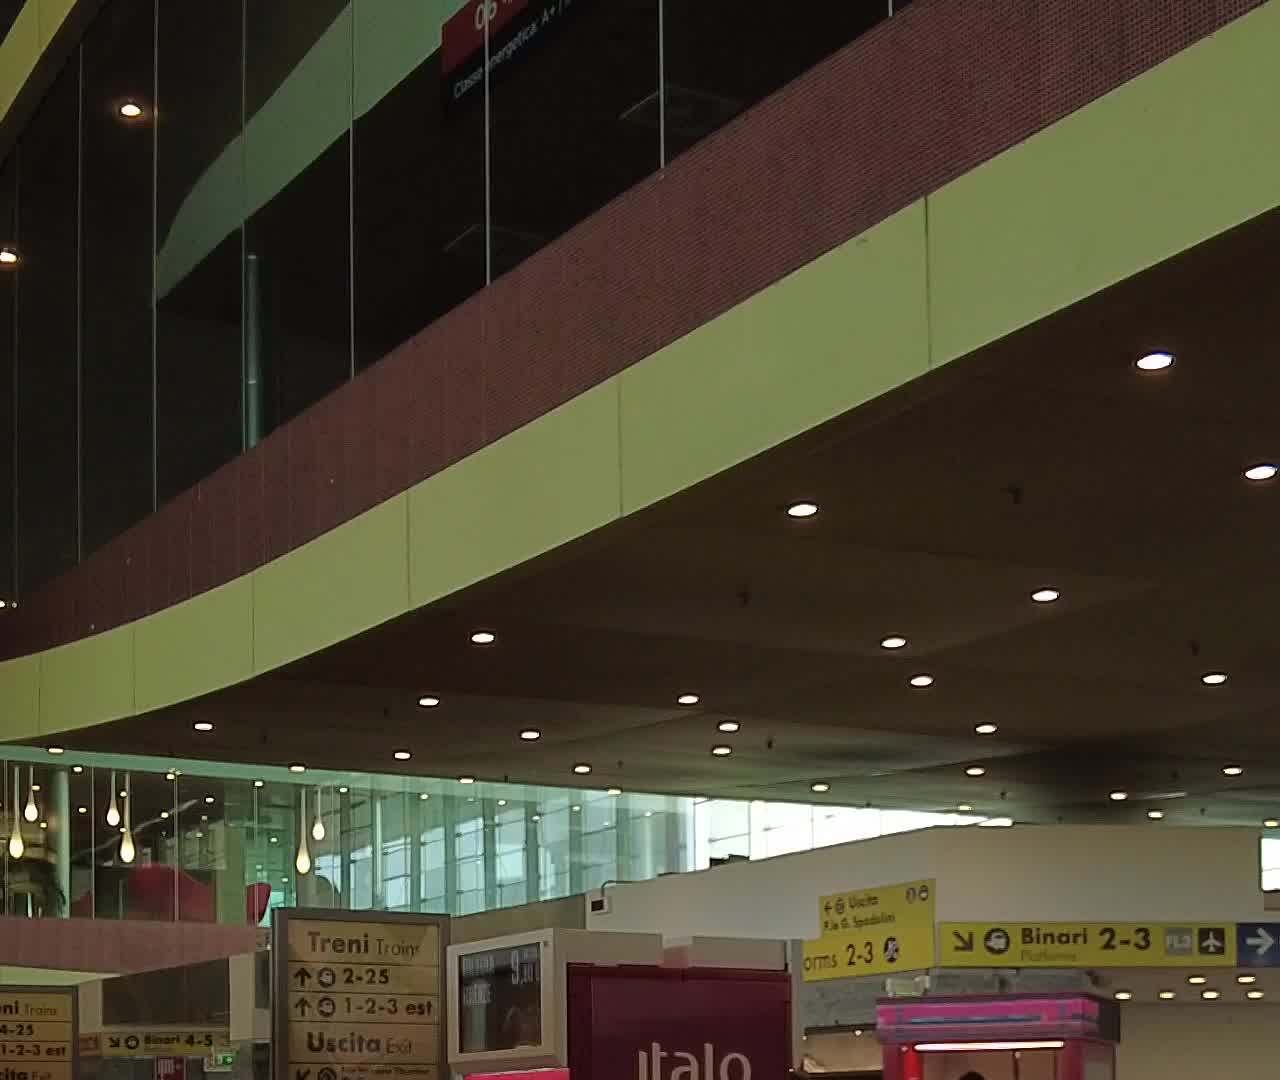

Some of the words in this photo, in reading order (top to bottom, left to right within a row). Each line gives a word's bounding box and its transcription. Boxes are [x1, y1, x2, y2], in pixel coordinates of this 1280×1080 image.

[308, 931, 370, 955] Treni
[1021, 927, 1088, 945] Binari
[1099, 927, 1152, 951] 2-3
[846, 941, 874, 966] 2-3
[343, 967, 390, 985] 2-25
[344, 997, 399, 1016] 1-2-3
[405, 1001, 432, 1016] est
[1, 1044, 41, 1056] 1-2-3
[185, 1034, 214, 1047] 4-5
[306, 1031, 381, 1053] Uscita
